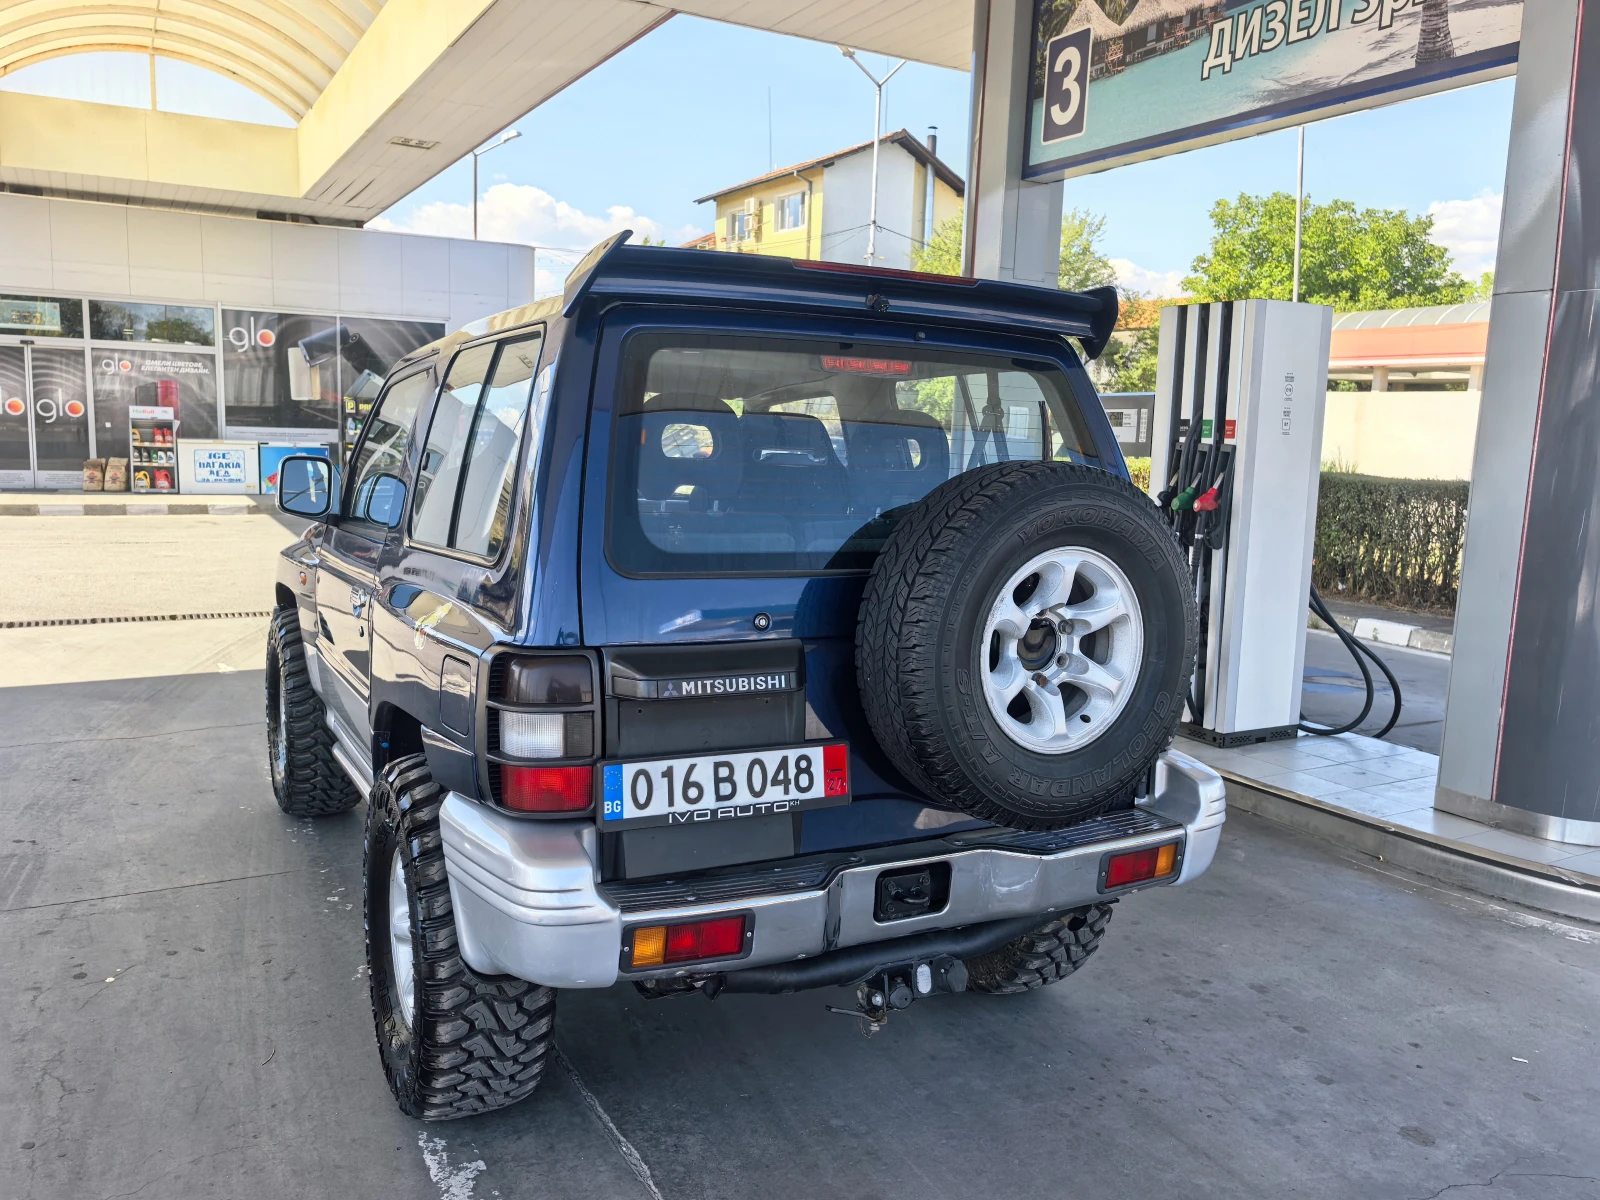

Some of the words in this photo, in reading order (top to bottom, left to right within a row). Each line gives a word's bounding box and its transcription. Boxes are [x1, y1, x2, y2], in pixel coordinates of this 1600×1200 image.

[1050, 46, 1083, 127] 3
[229, 317, 276, 352] glo
[102, 353, 132, 374] glo
[0, 386, 25, 416] lo
[36, 388, 85, 424] glo
[1017, 505, 1168, 572] YOKOHAMA
[682, 674, 786, 696] MITSUBISHI
[1007, 691, 1171, 798] GEOLANDAR
[630, 763, 704, 811] 016
[713, 760, 737, 803] B
[746, 754, 815, 798] 048
[604, 800, 622, 814] BG
[668, 810, 711, 824] IVO
[717, 801, 790, 819] AUTO
